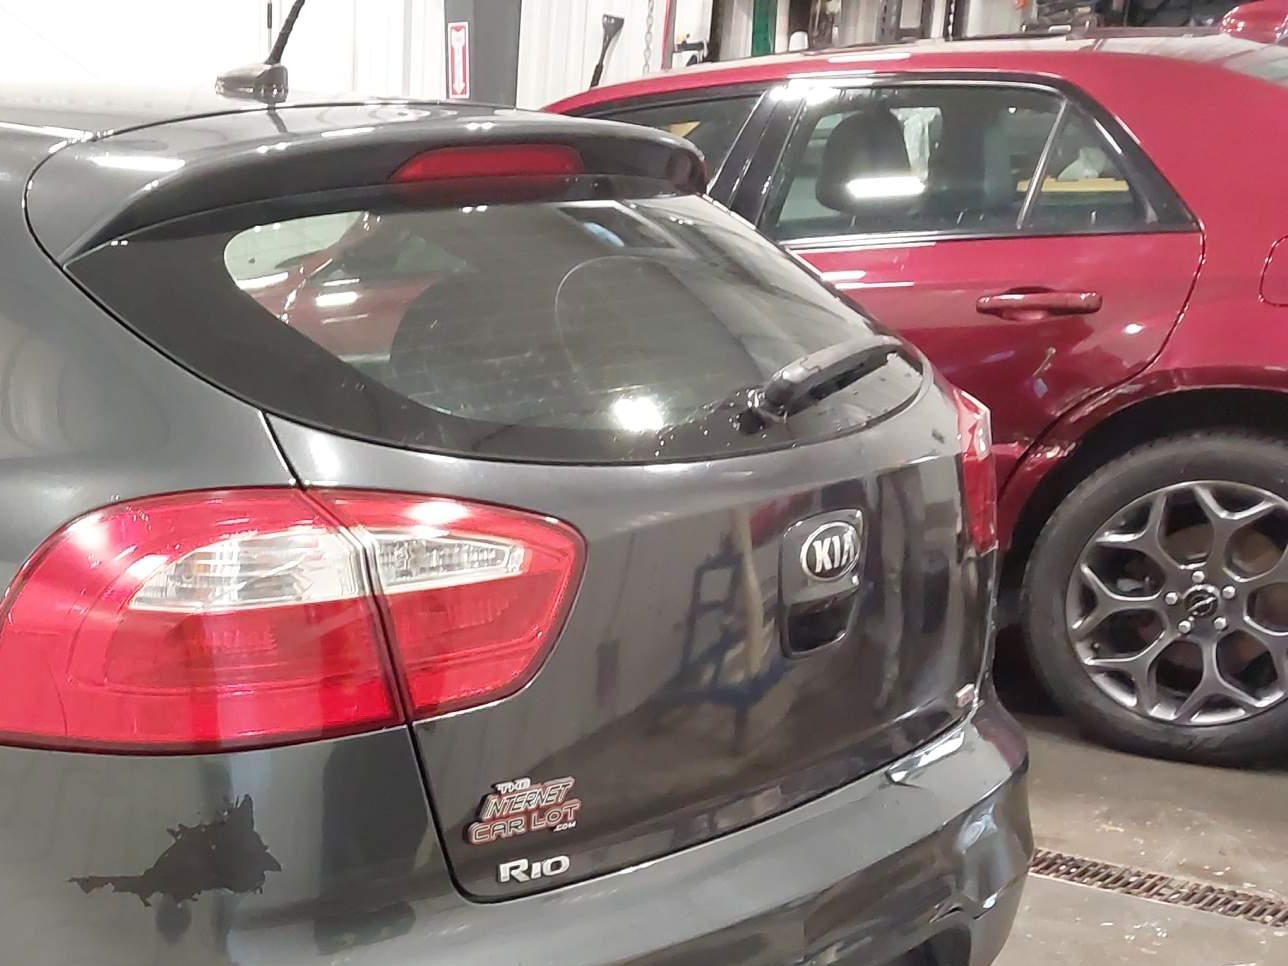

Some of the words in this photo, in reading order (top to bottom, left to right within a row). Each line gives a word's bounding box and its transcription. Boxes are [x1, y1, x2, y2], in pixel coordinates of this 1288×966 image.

[812, 529, 855, 573] KIA
[483, 777, 575, 819] INTERNET
[471, 815, 527, 845] CAR
[532, 800, 582, 831] LOT
